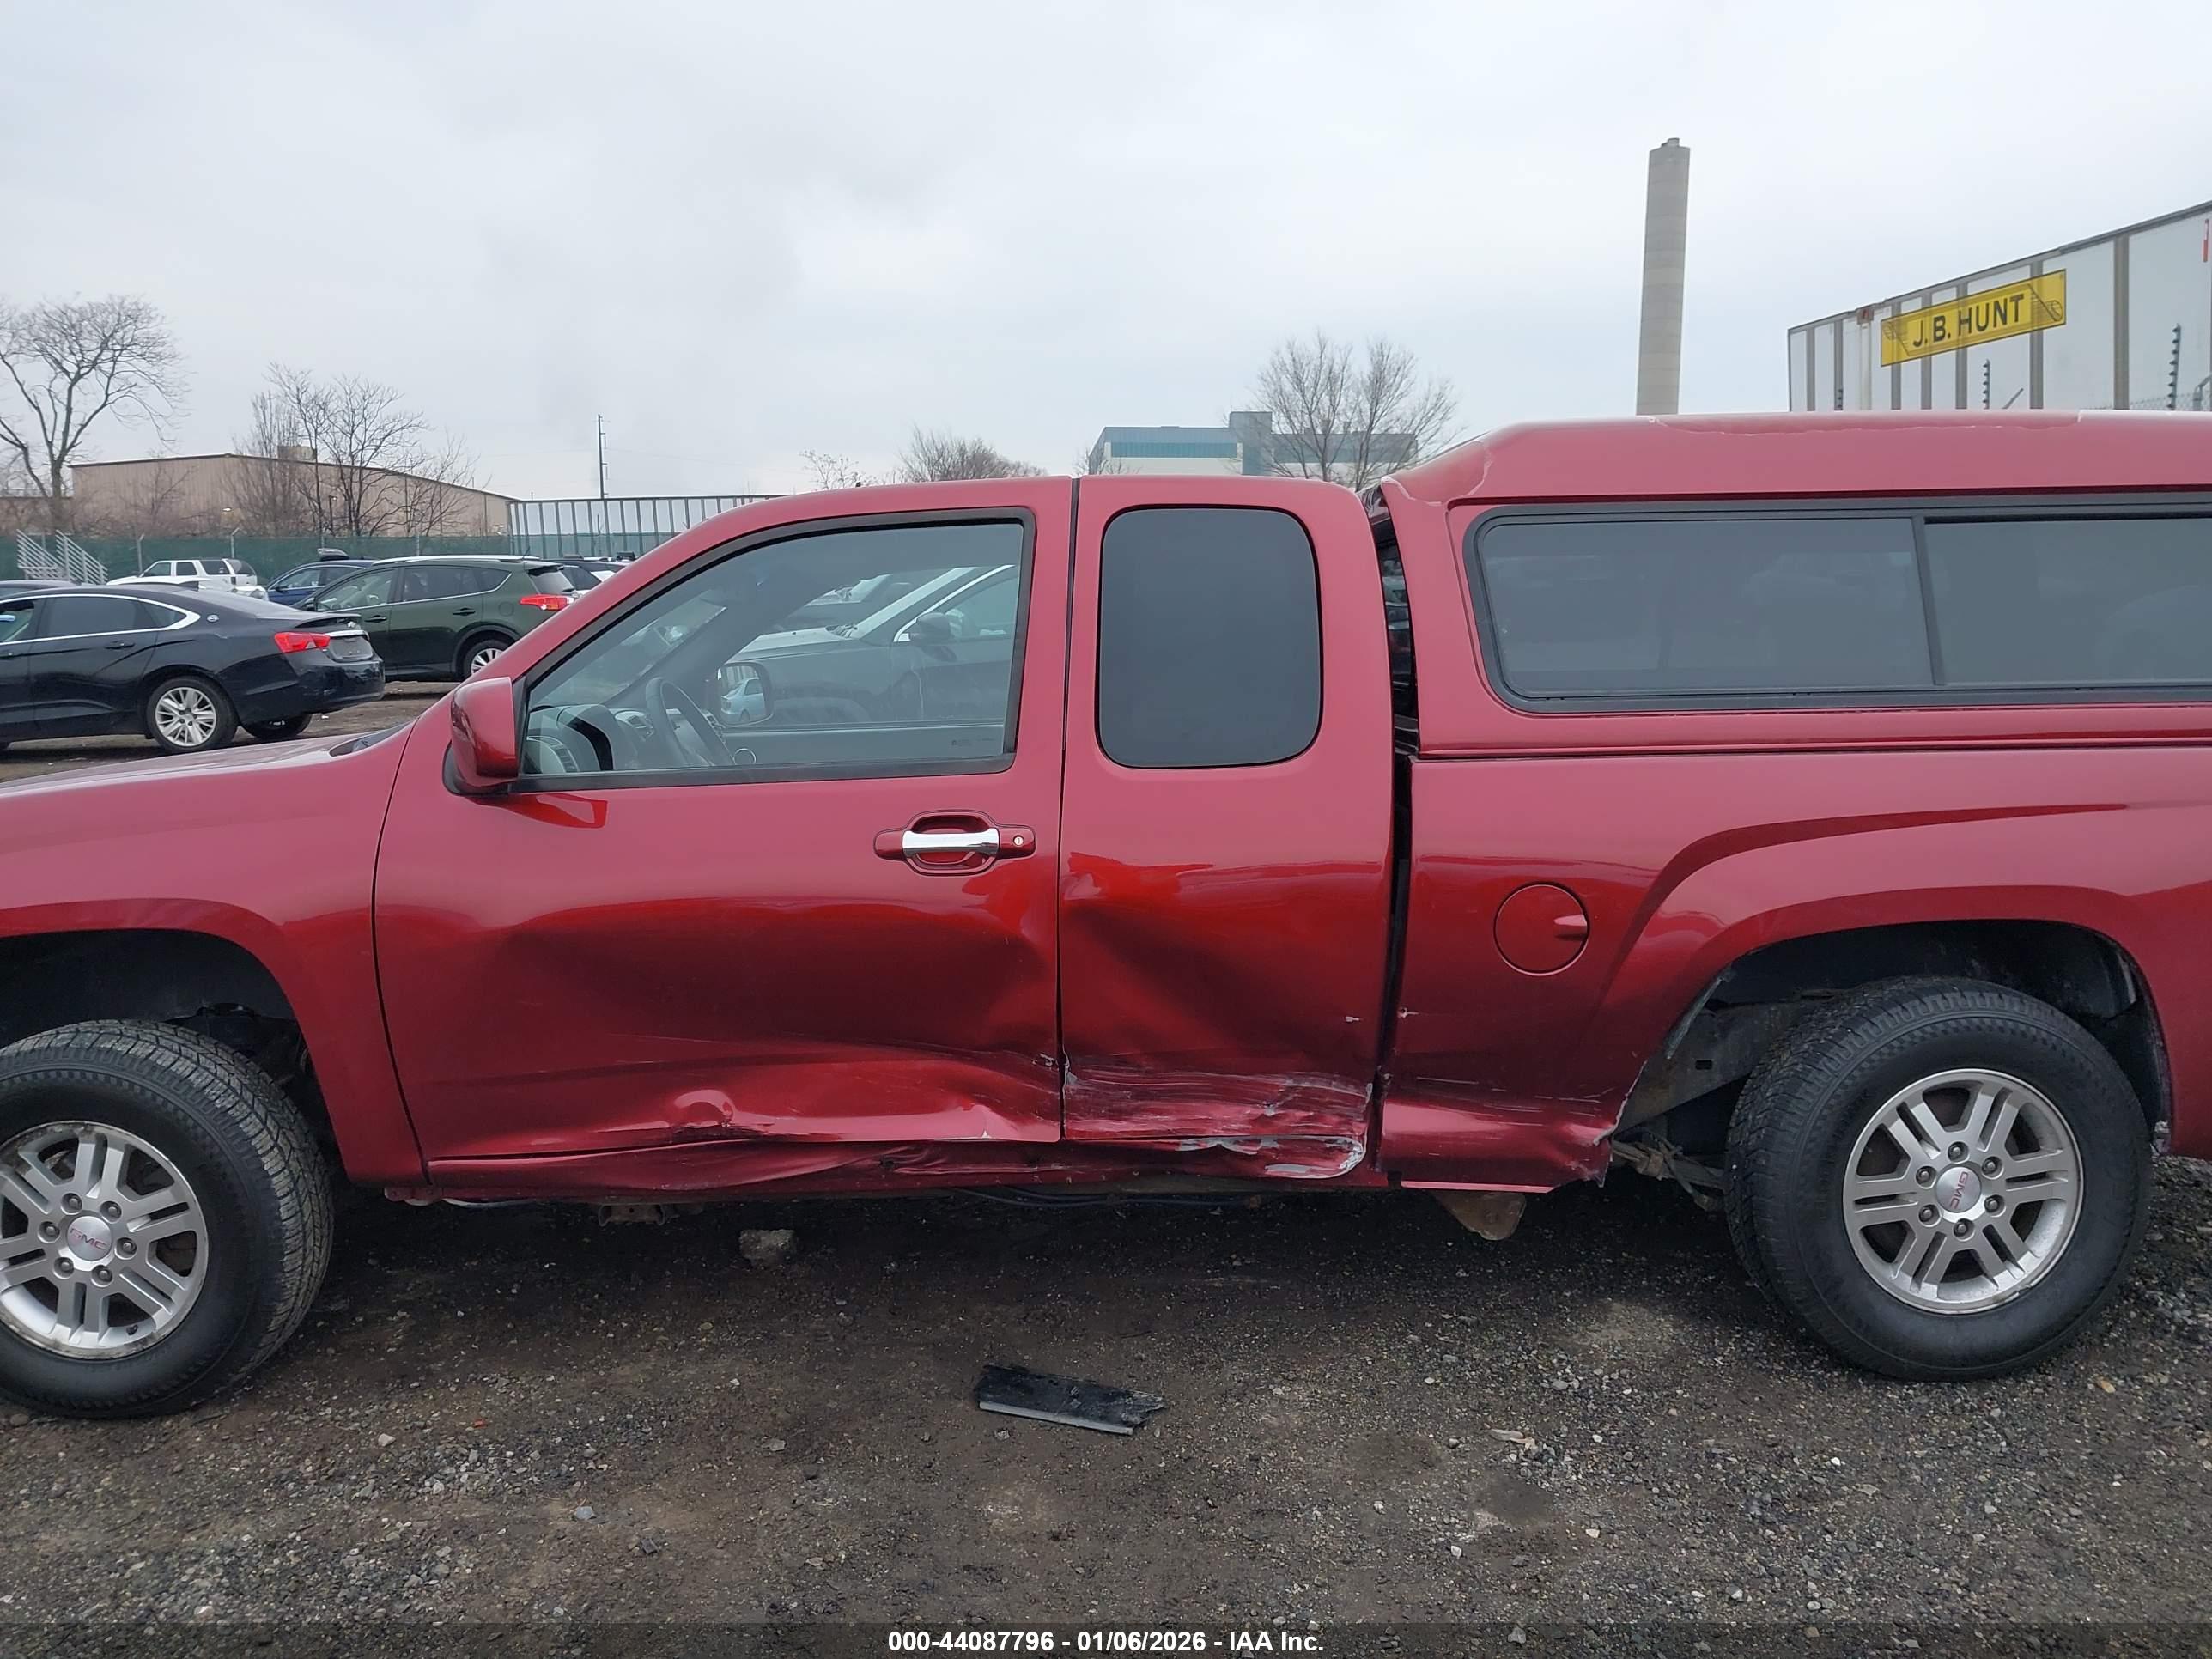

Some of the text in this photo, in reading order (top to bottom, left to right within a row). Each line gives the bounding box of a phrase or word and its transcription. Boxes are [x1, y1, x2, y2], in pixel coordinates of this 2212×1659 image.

[1958, 295, 2025, 336] HUNT
[1949, 1171, 1970, 1210] GMC
[70, 1228, 109, 1251] GMC
